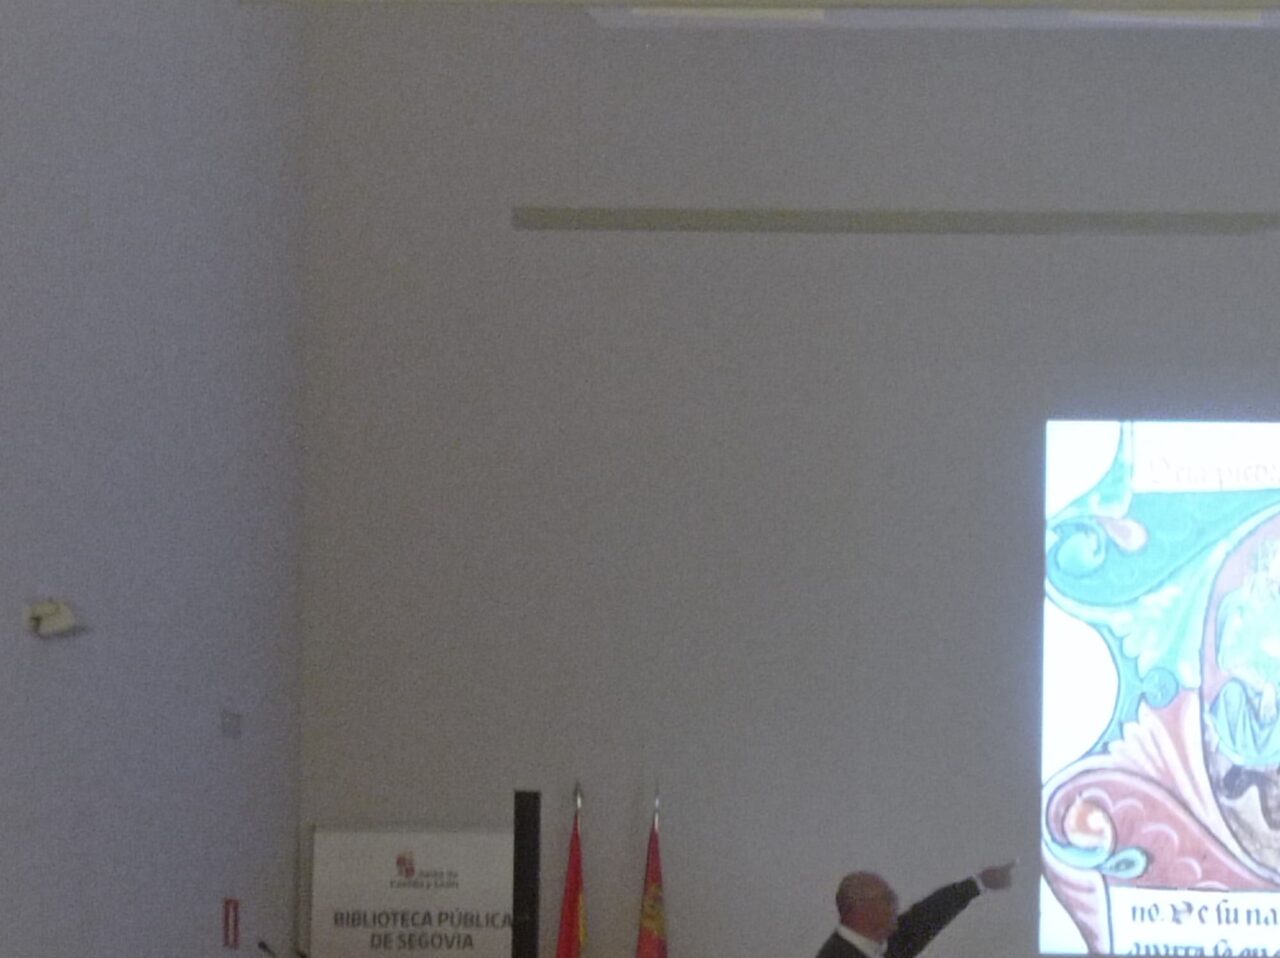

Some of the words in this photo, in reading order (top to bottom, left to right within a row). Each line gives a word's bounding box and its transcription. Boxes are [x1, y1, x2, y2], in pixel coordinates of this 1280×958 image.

[334, 910, 432, 928] BIBLIOTECA
[438, 907, 514, 928] PÚBLICA
[370, 933, 394, 950] DE
[397, 933, 475, 950] SEGOVIA
